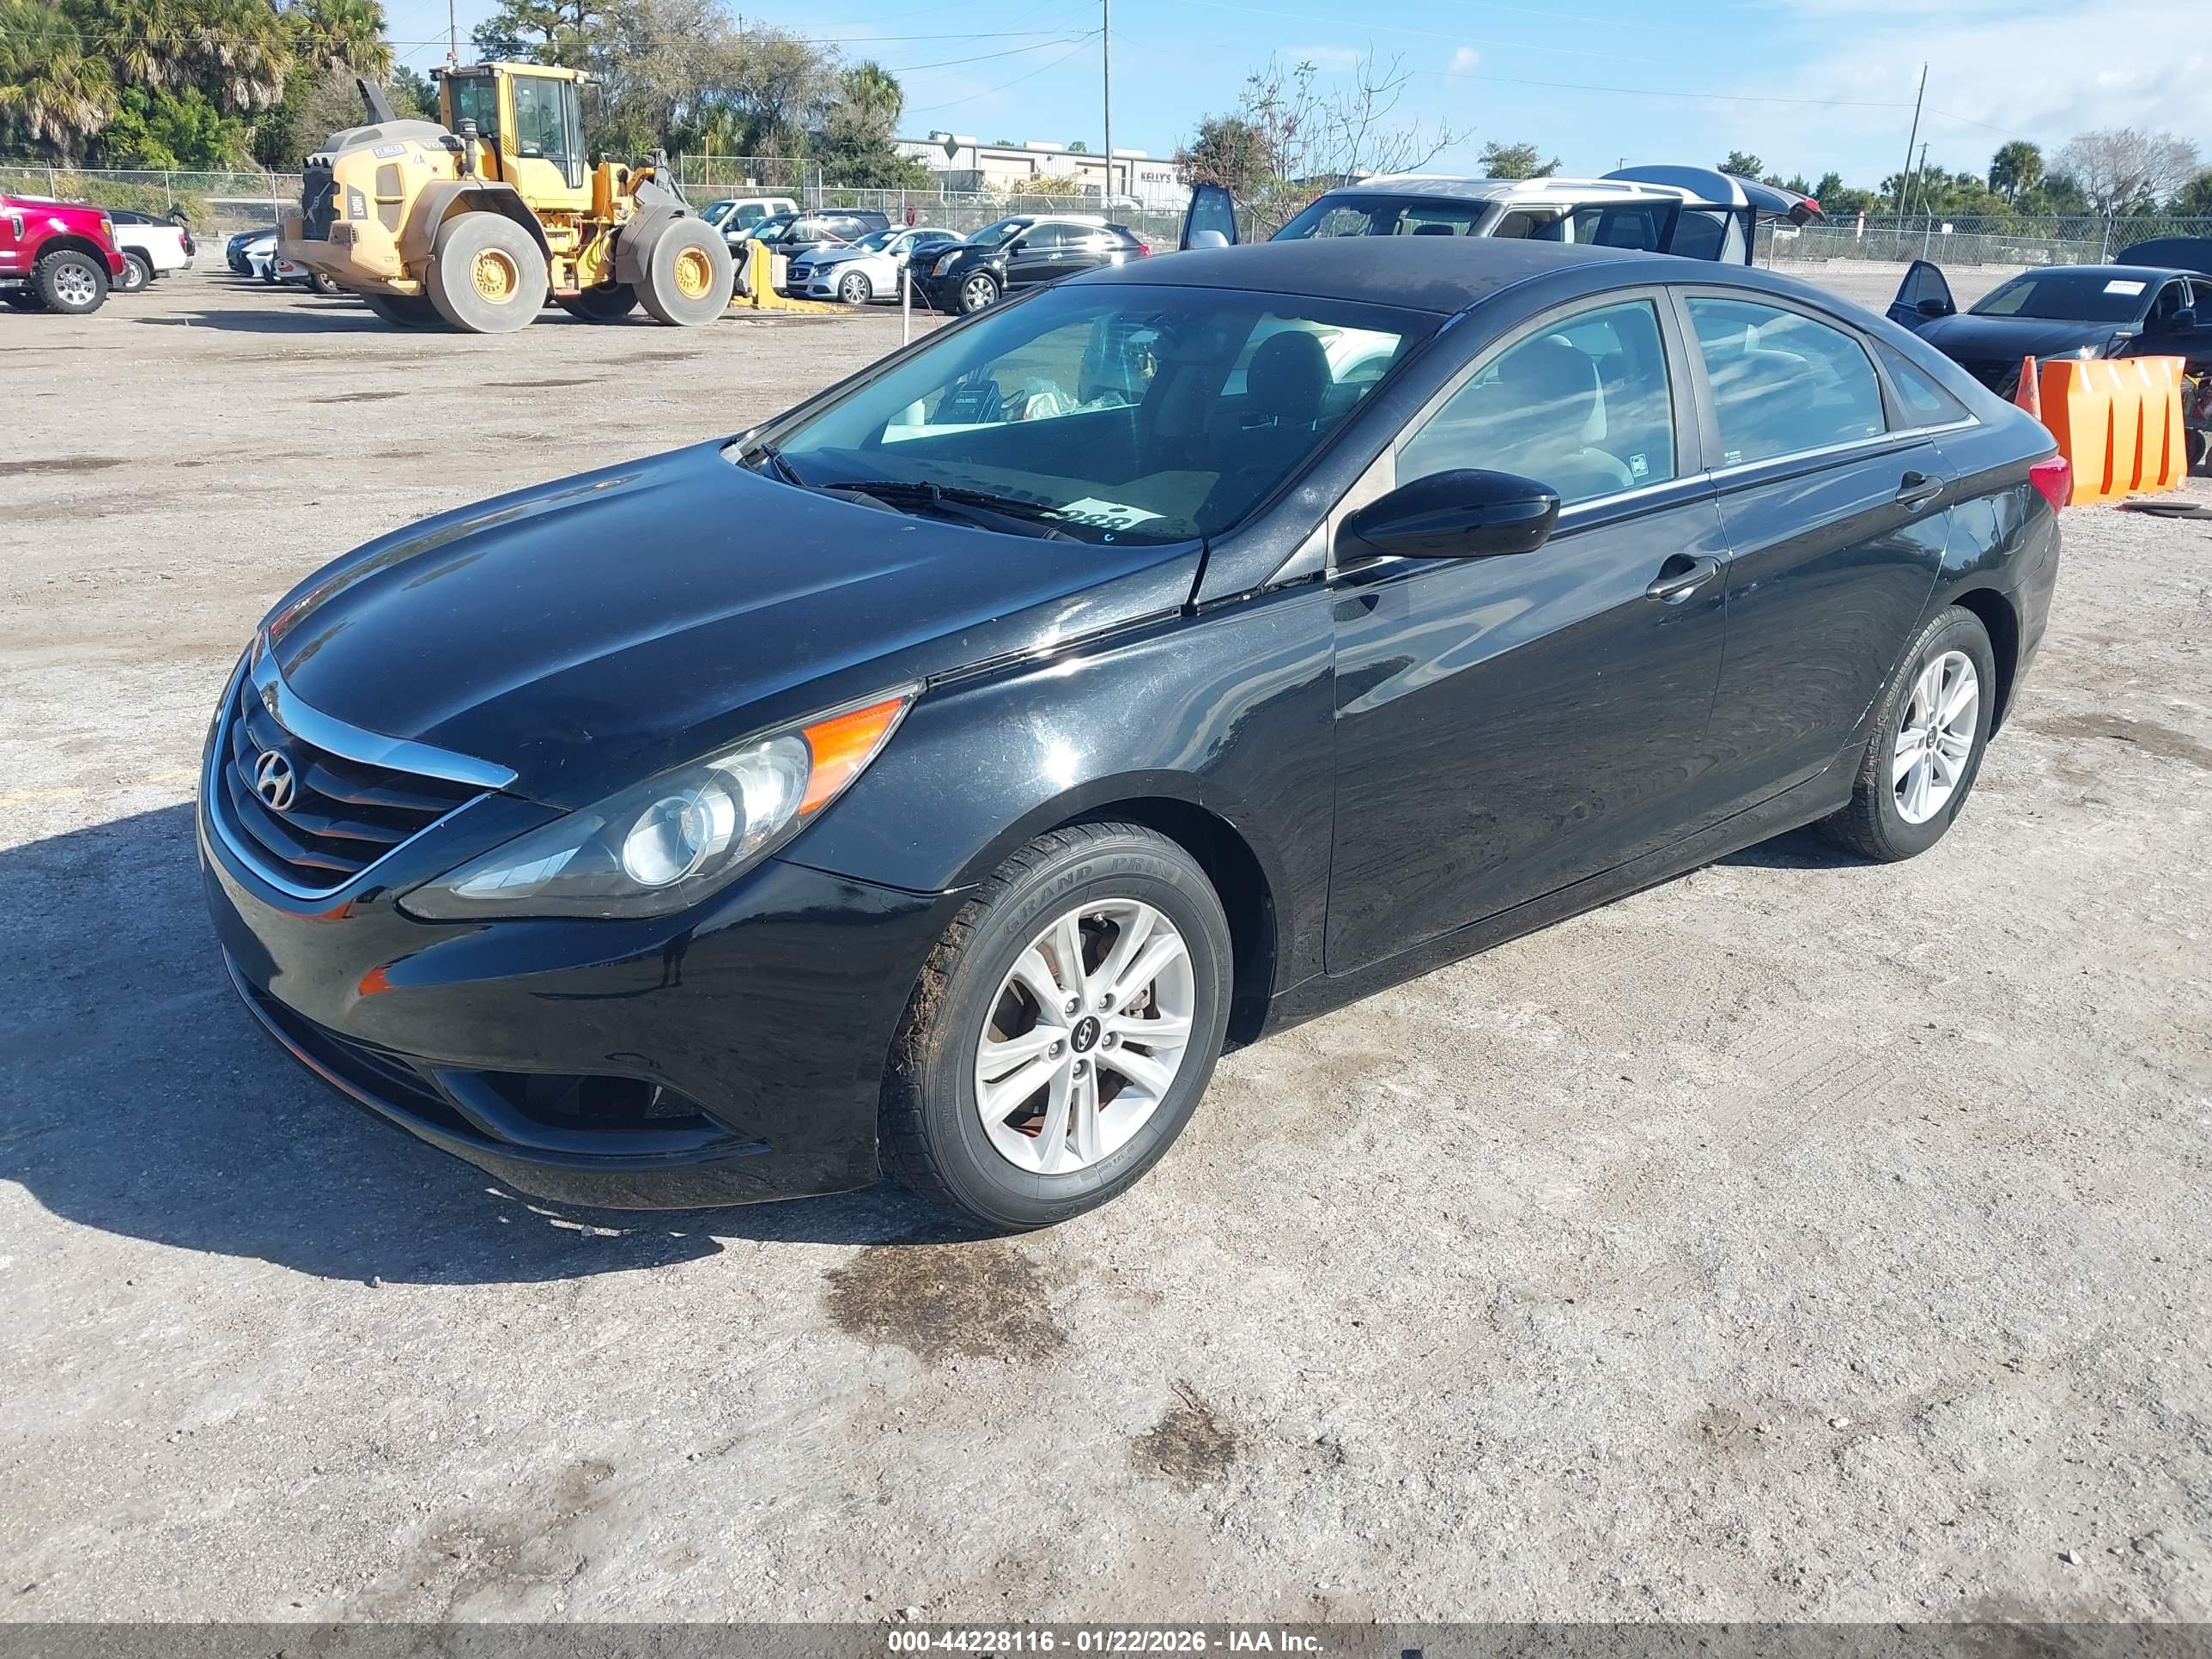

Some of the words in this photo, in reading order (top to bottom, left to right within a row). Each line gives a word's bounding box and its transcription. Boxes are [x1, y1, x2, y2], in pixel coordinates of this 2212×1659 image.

[1140, 172, 1171, 184] KELLY'S
[350, 195, 365, 216] L90H
[1003, 865, 1094, 937] GRAND
[1110, 857, 1170, 879] PRIX
